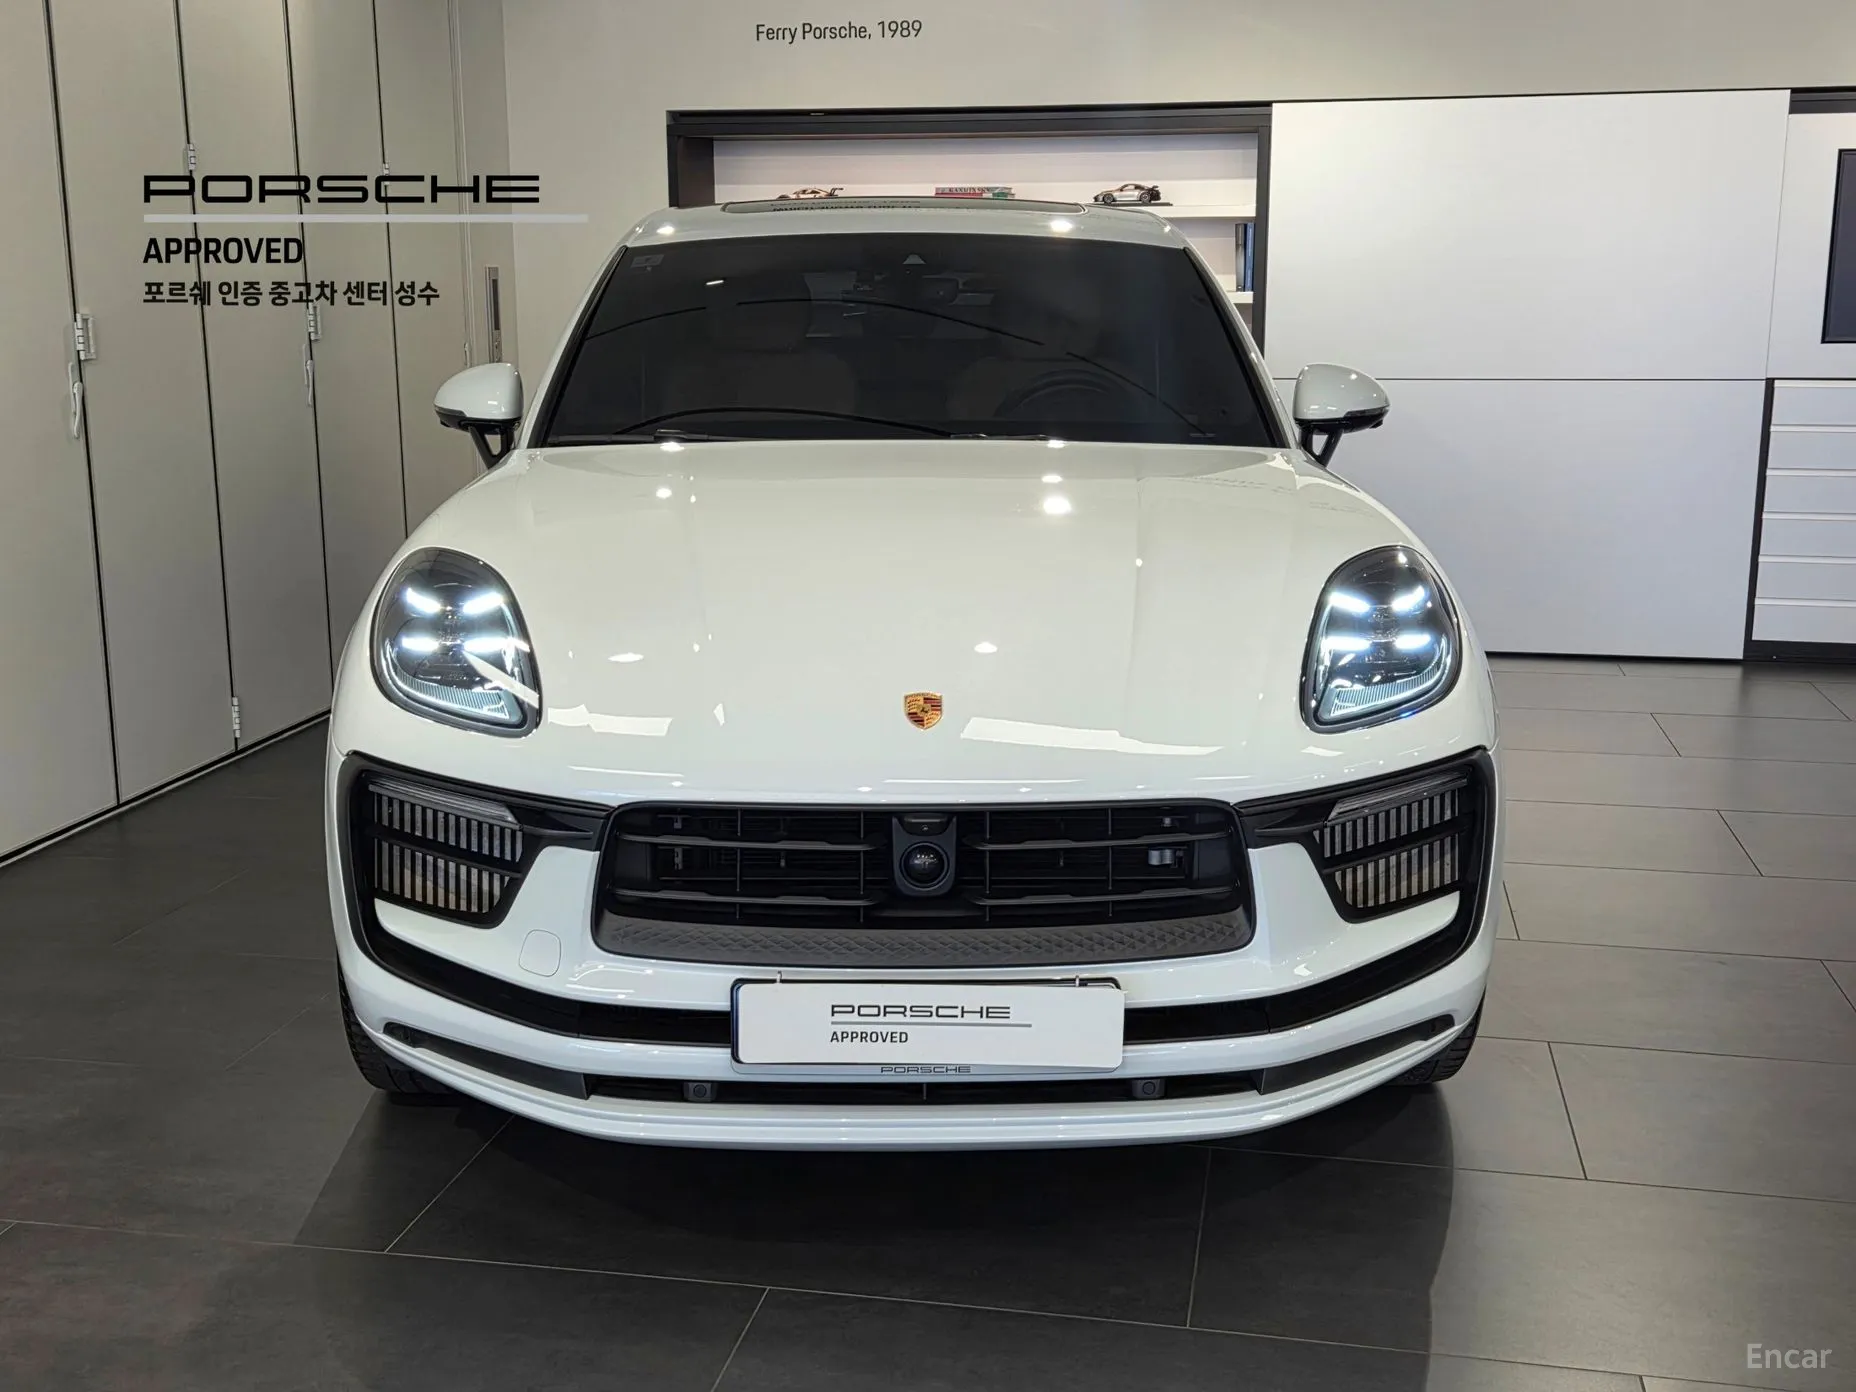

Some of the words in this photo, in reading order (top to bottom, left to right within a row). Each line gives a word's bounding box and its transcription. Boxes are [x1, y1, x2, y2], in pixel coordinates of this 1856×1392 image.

[756, 24, 798, 45] Ferry
[802, 21, 872, 40] Porsche,
[877, 20, 923, 38] 1989
[831, 1004, 1011, 1019] PORSCHE
[830, 1031, 909, 1043] APPROVED
[880, 1066, 971, 1074] PORSCHE
